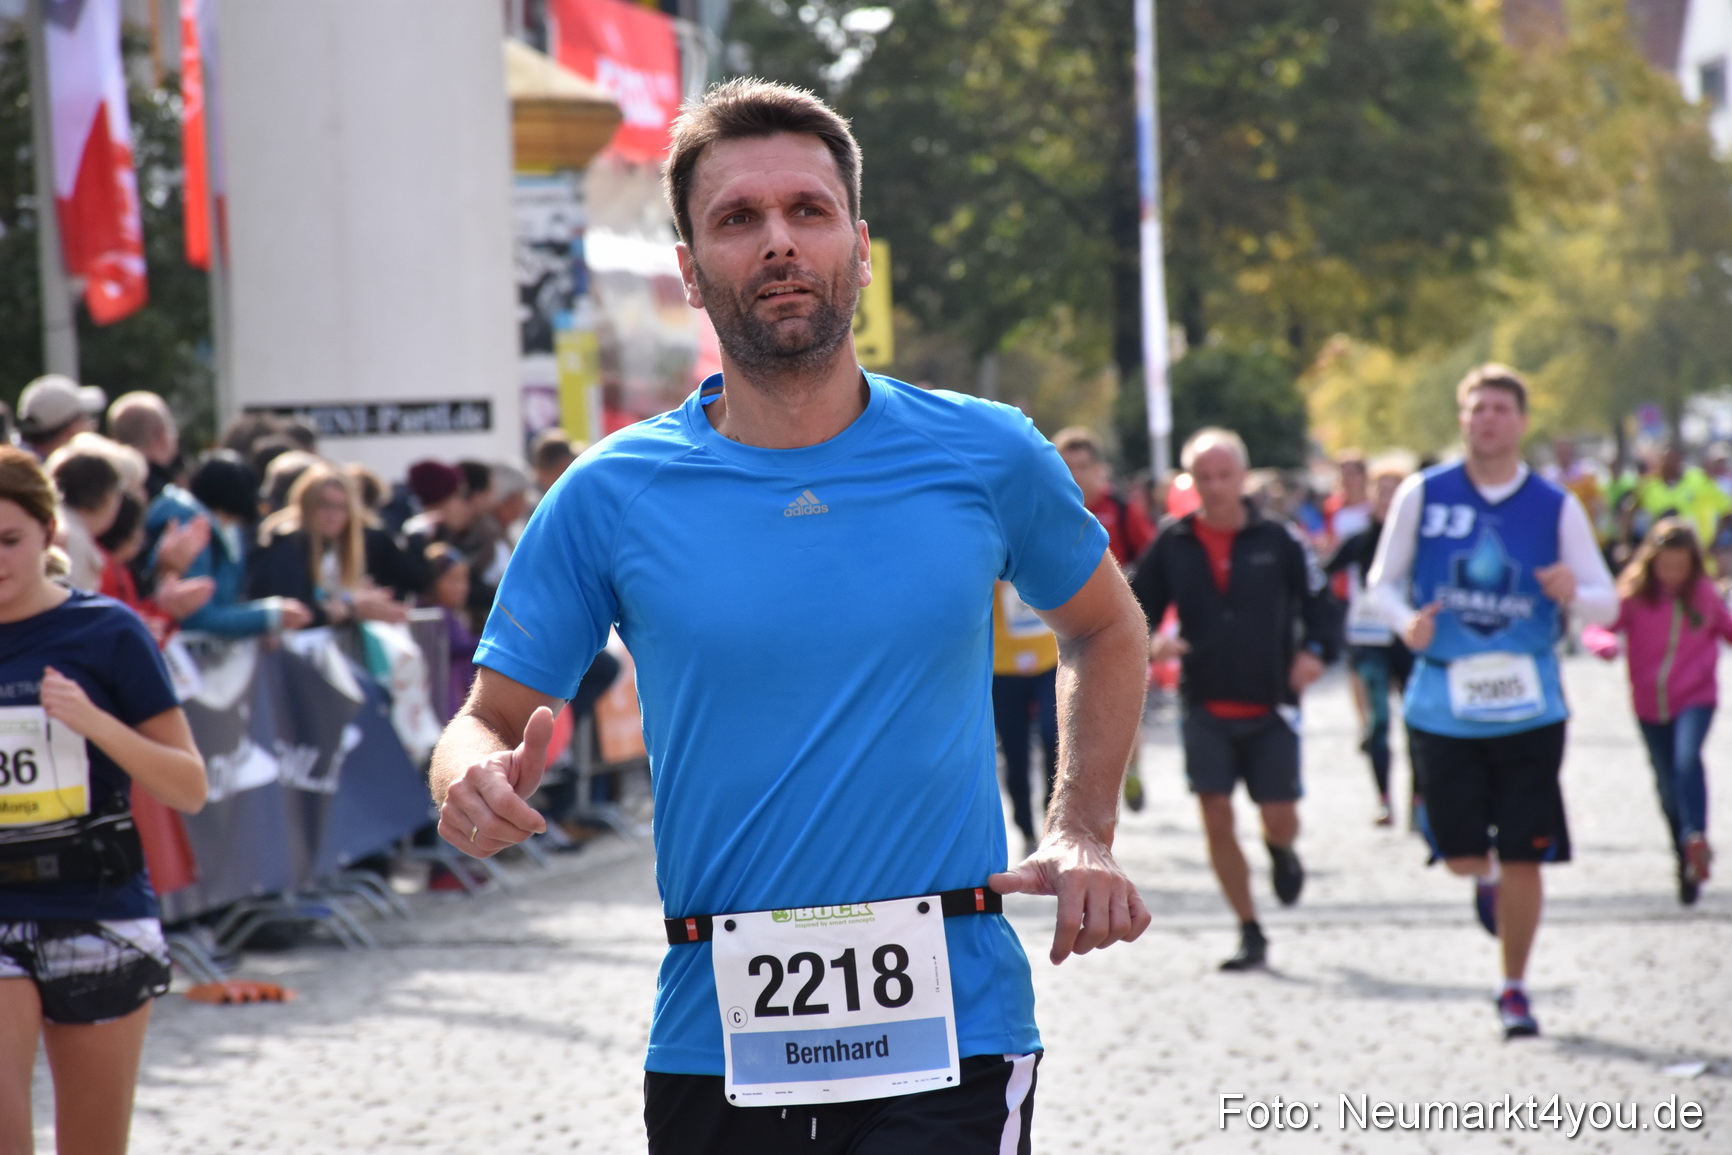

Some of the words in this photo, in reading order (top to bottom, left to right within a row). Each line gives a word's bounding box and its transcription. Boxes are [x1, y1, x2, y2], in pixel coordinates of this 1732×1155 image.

[783, 504, 829, 517] adidas
[1421, 503, 1476, 539] 33
[848, 917, 875, 925] concepts
[748, 943, 914, 1018] 2218
[785, 1034, 890, 1065] Bernhard
